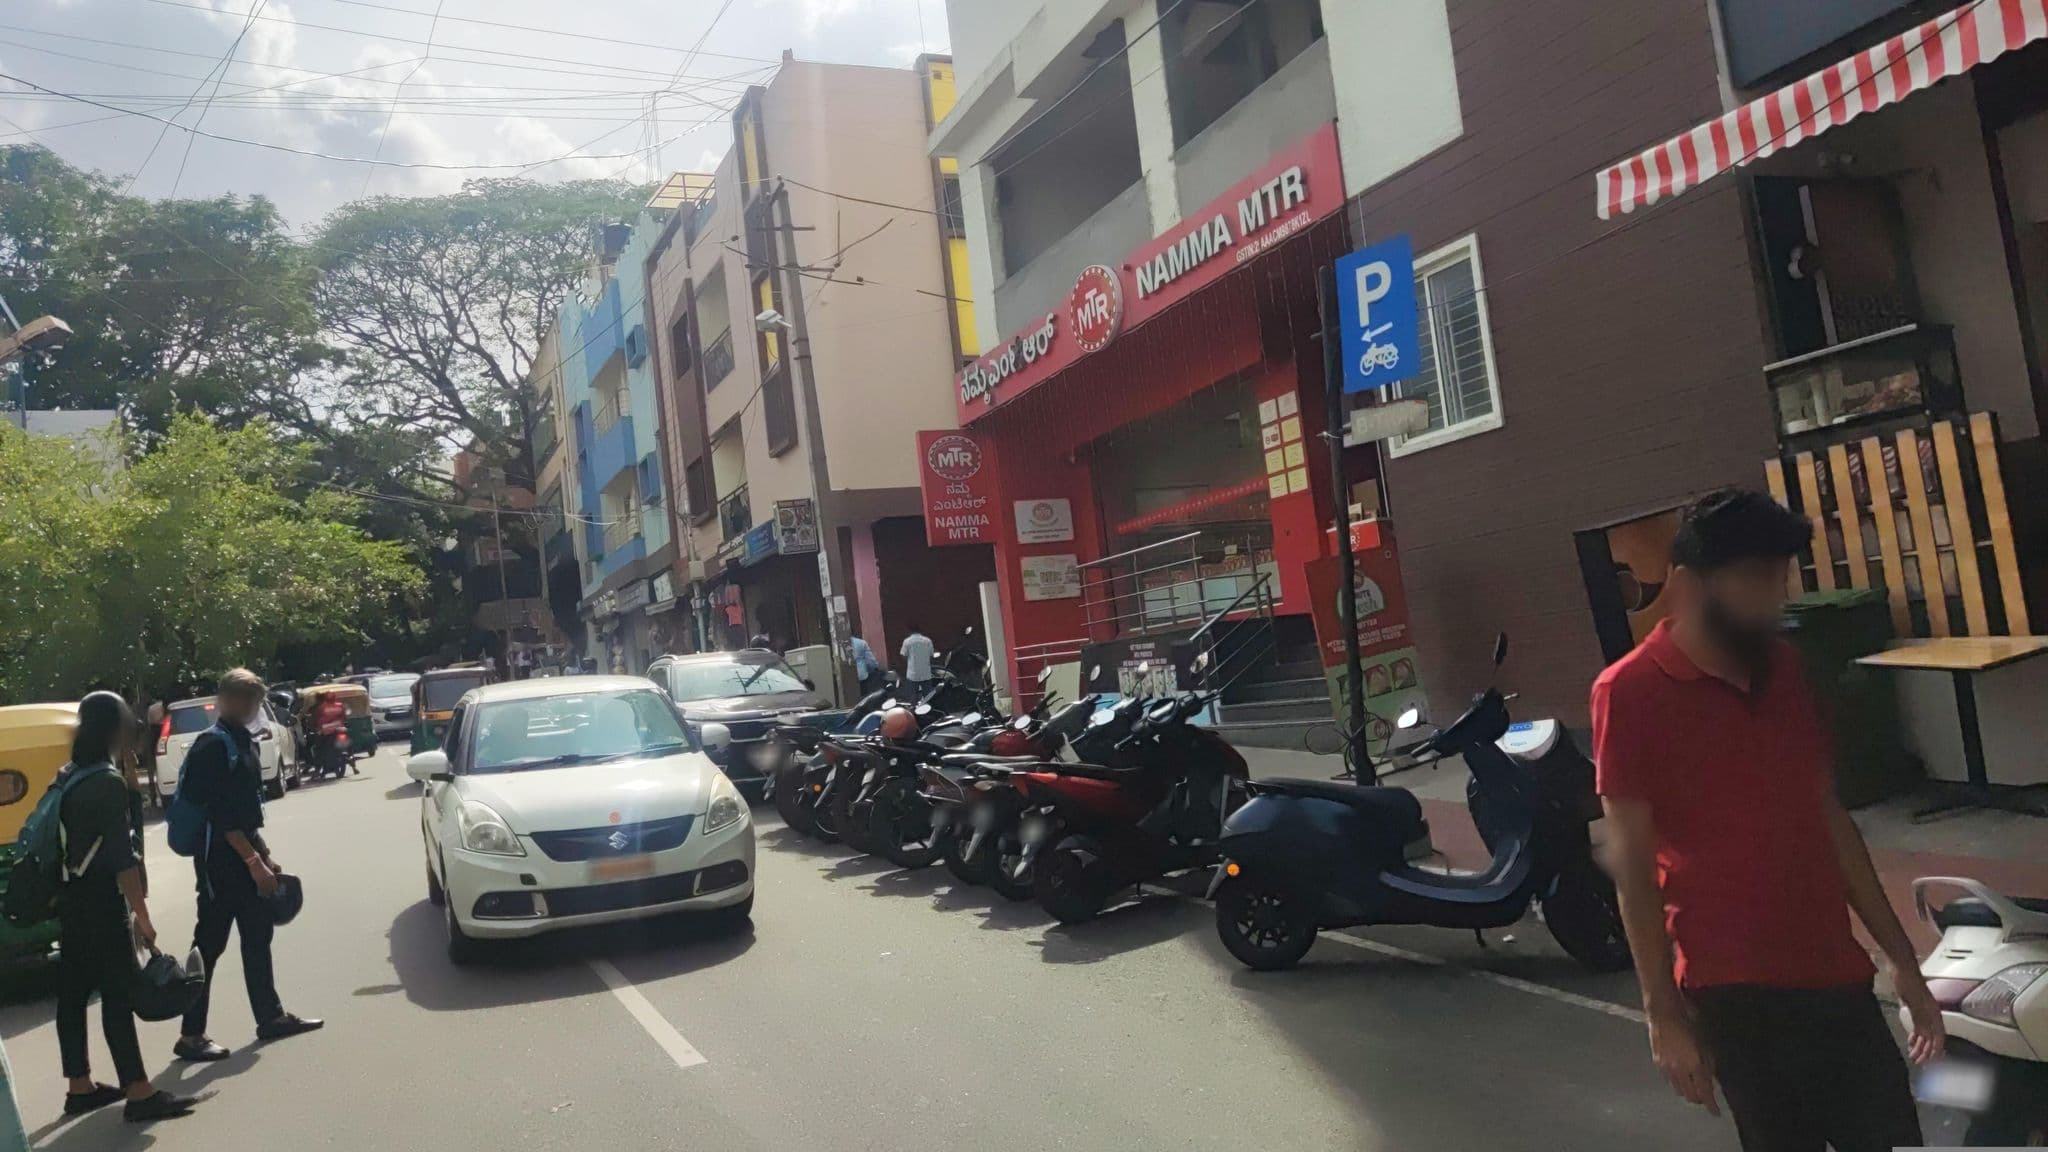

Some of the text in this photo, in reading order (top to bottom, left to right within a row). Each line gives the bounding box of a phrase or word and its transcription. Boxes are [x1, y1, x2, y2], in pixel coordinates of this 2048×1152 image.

[1135, 165, 1305, 300] NAMMA MTR
[1077, 287, 1110, 336] MTR
[1356, 260, 1392, 328] P
[937, 447, 973, 468] MTR
[935, 514, 990, 528] NAMMA
[948, 526, 980, 540] MTR
